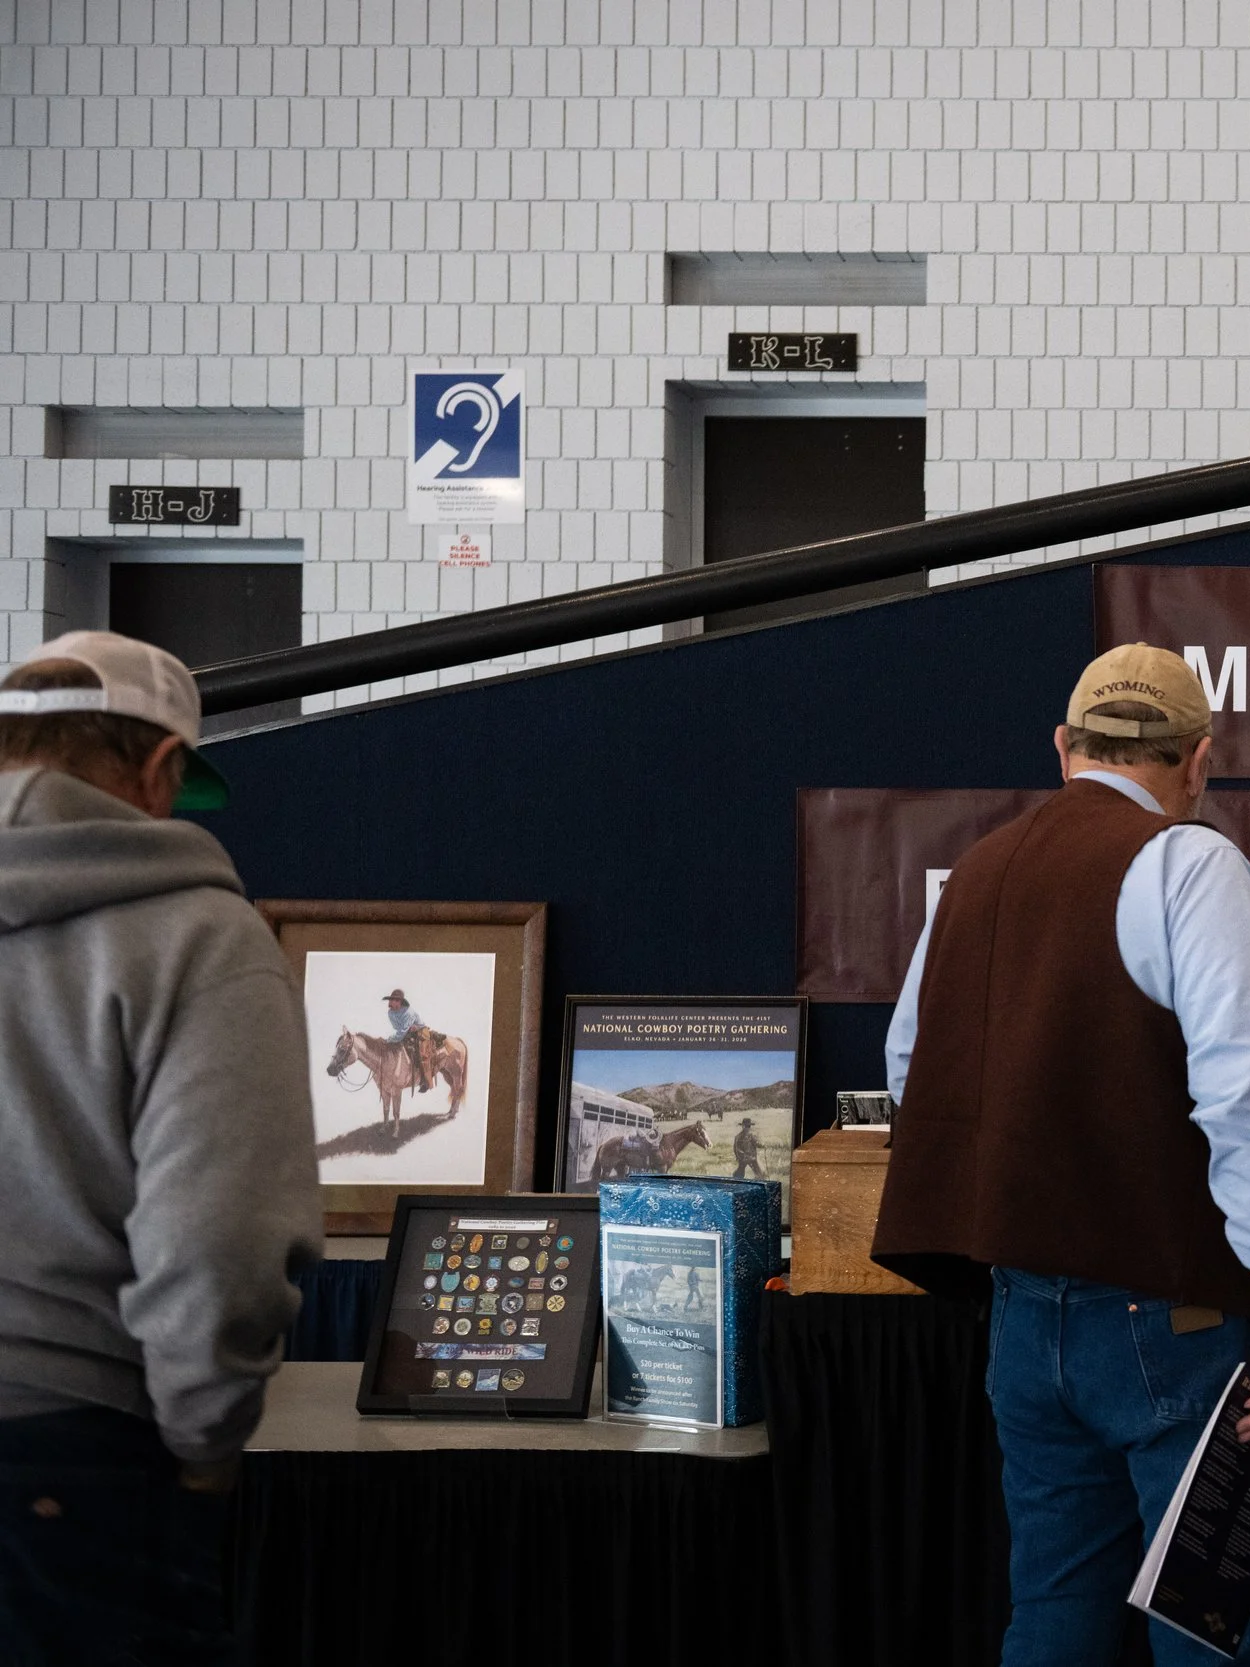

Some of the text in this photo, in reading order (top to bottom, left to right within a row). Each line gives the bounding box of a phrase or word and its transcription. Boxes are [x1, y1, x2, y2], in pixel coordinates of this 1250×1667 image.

[750, 336, 833, 369] K-L
[417, 485, 445, 493] Hearing
[131, 490, 215, 522] H-J
[1092, 680, 1166, 700] WYOMING
[583, 1024, 788, 1034] NATIONAL COWBOY POETRY GATHERING
[682, 1249, 711, 1257] GATHERING
[626, 1324, 700, 1339] Buy A Chance To Win
[633, 1338, 658, 1347] Complete
[693, 1343, 705, 1351] Pins
[495, 1347, 518, 1356] RIDE
[640, 1360, 683, 1370] $20 per ticket
[645, 1373, 666, 1382] tickets
[666, 1375, 676, 1383] for
[677, 1376, 693, 1384] $100
